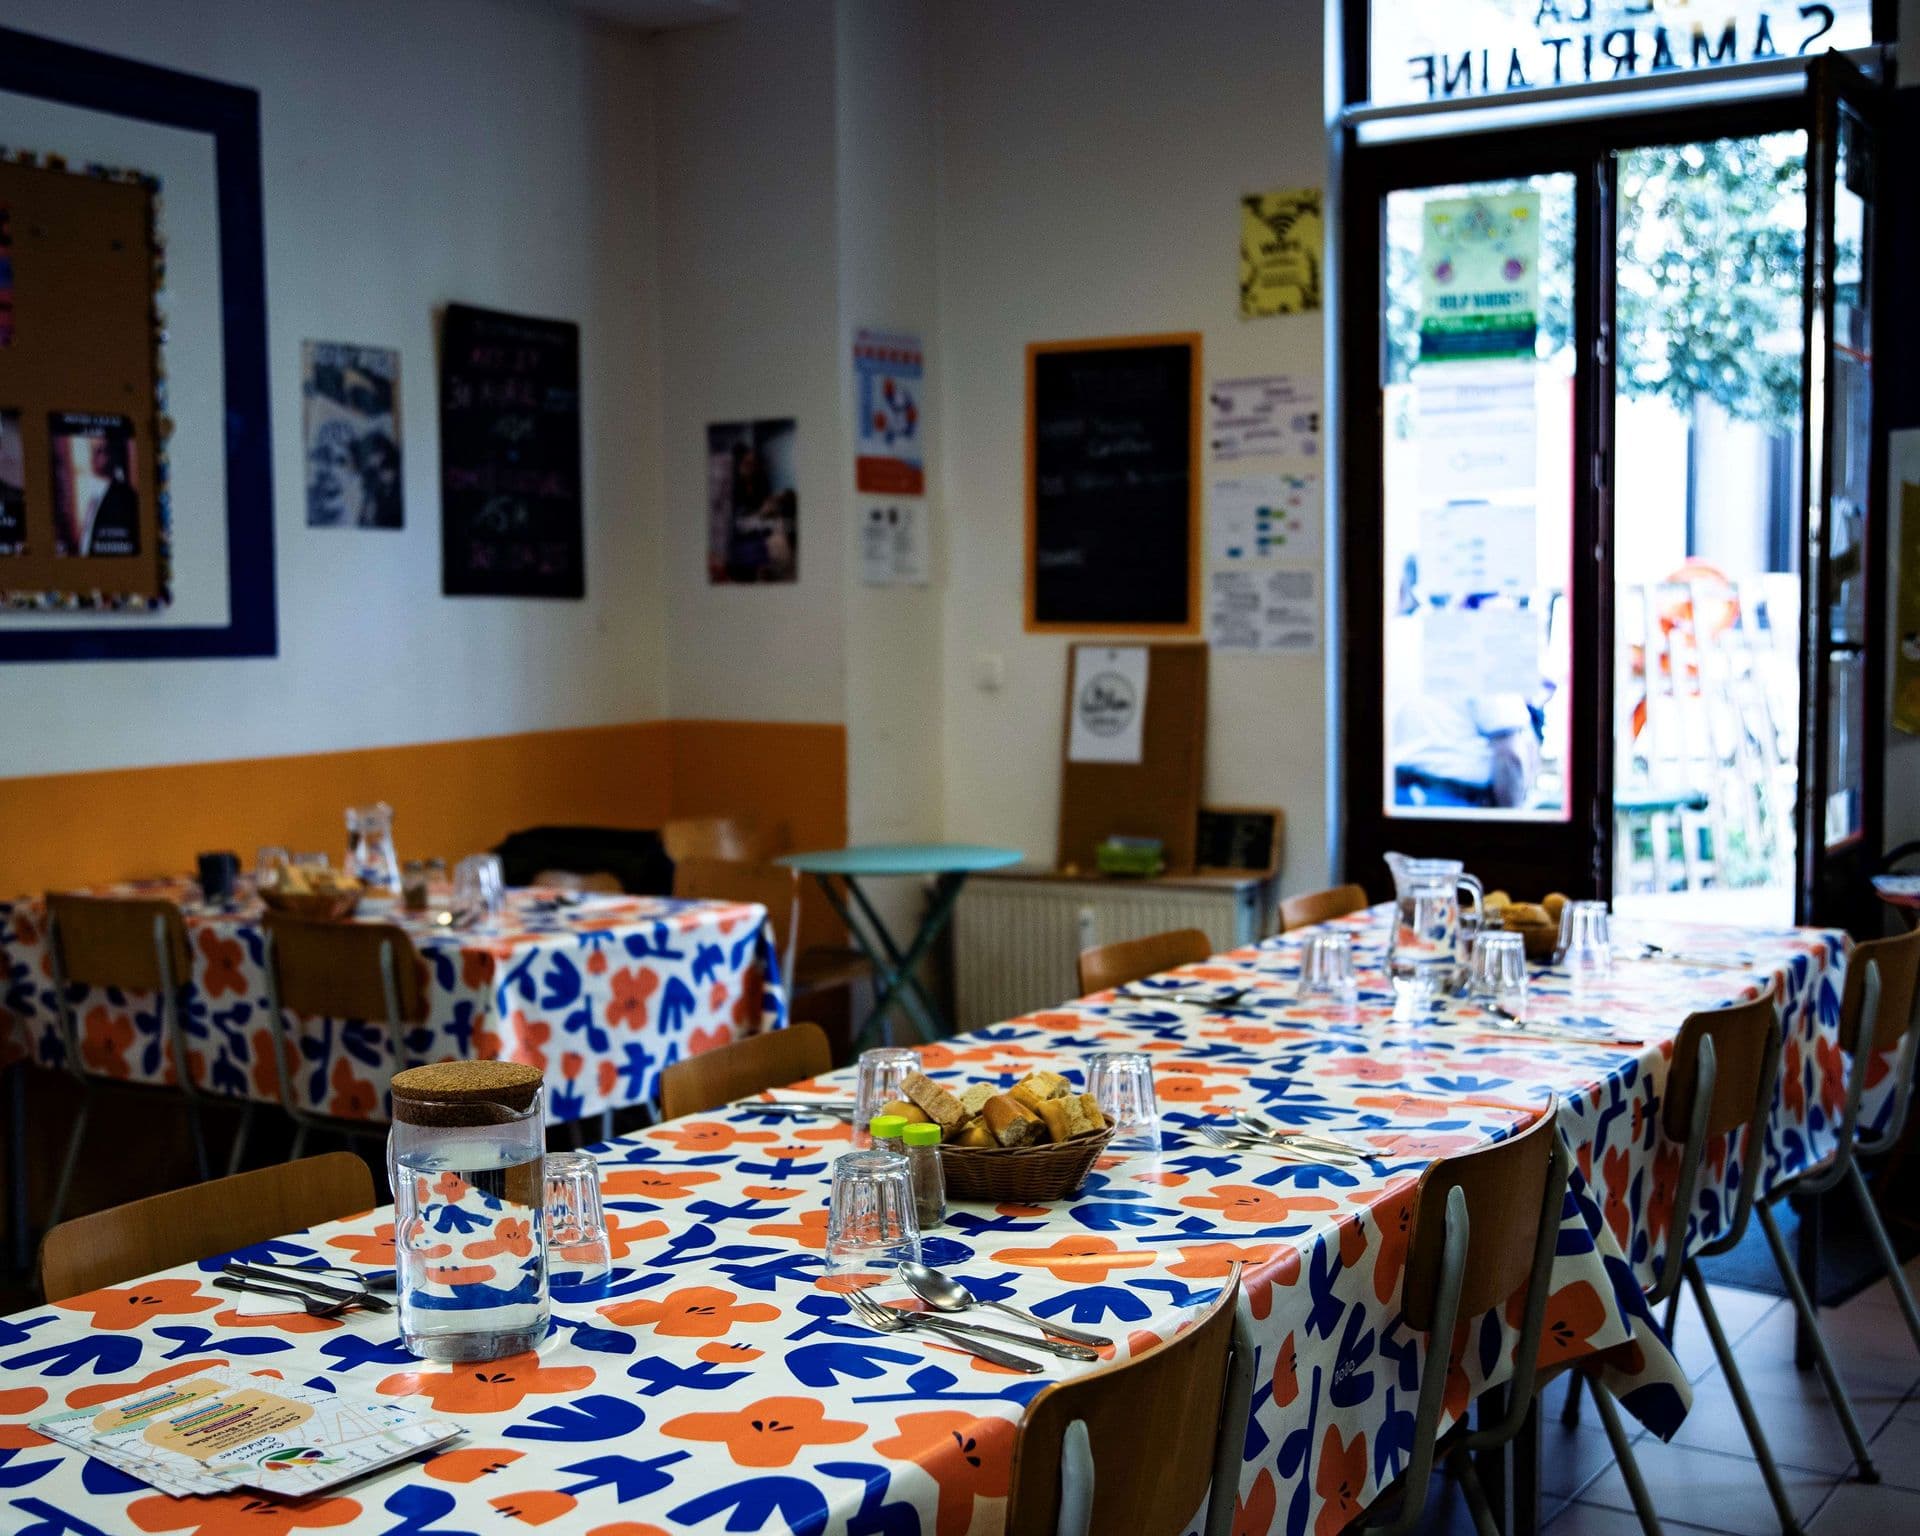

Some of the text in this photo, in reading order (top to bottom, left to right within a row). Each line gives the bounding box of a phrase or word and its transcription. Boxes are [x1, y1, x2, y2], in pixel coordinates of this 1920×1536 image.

[269, 1415, 300, 1429] Carte
[187, 1427, 237, 1447] Bruxelles
[219, 1435, 276, 1460] Solidaires
[238, 1442, 285, 1460] Saveurs
